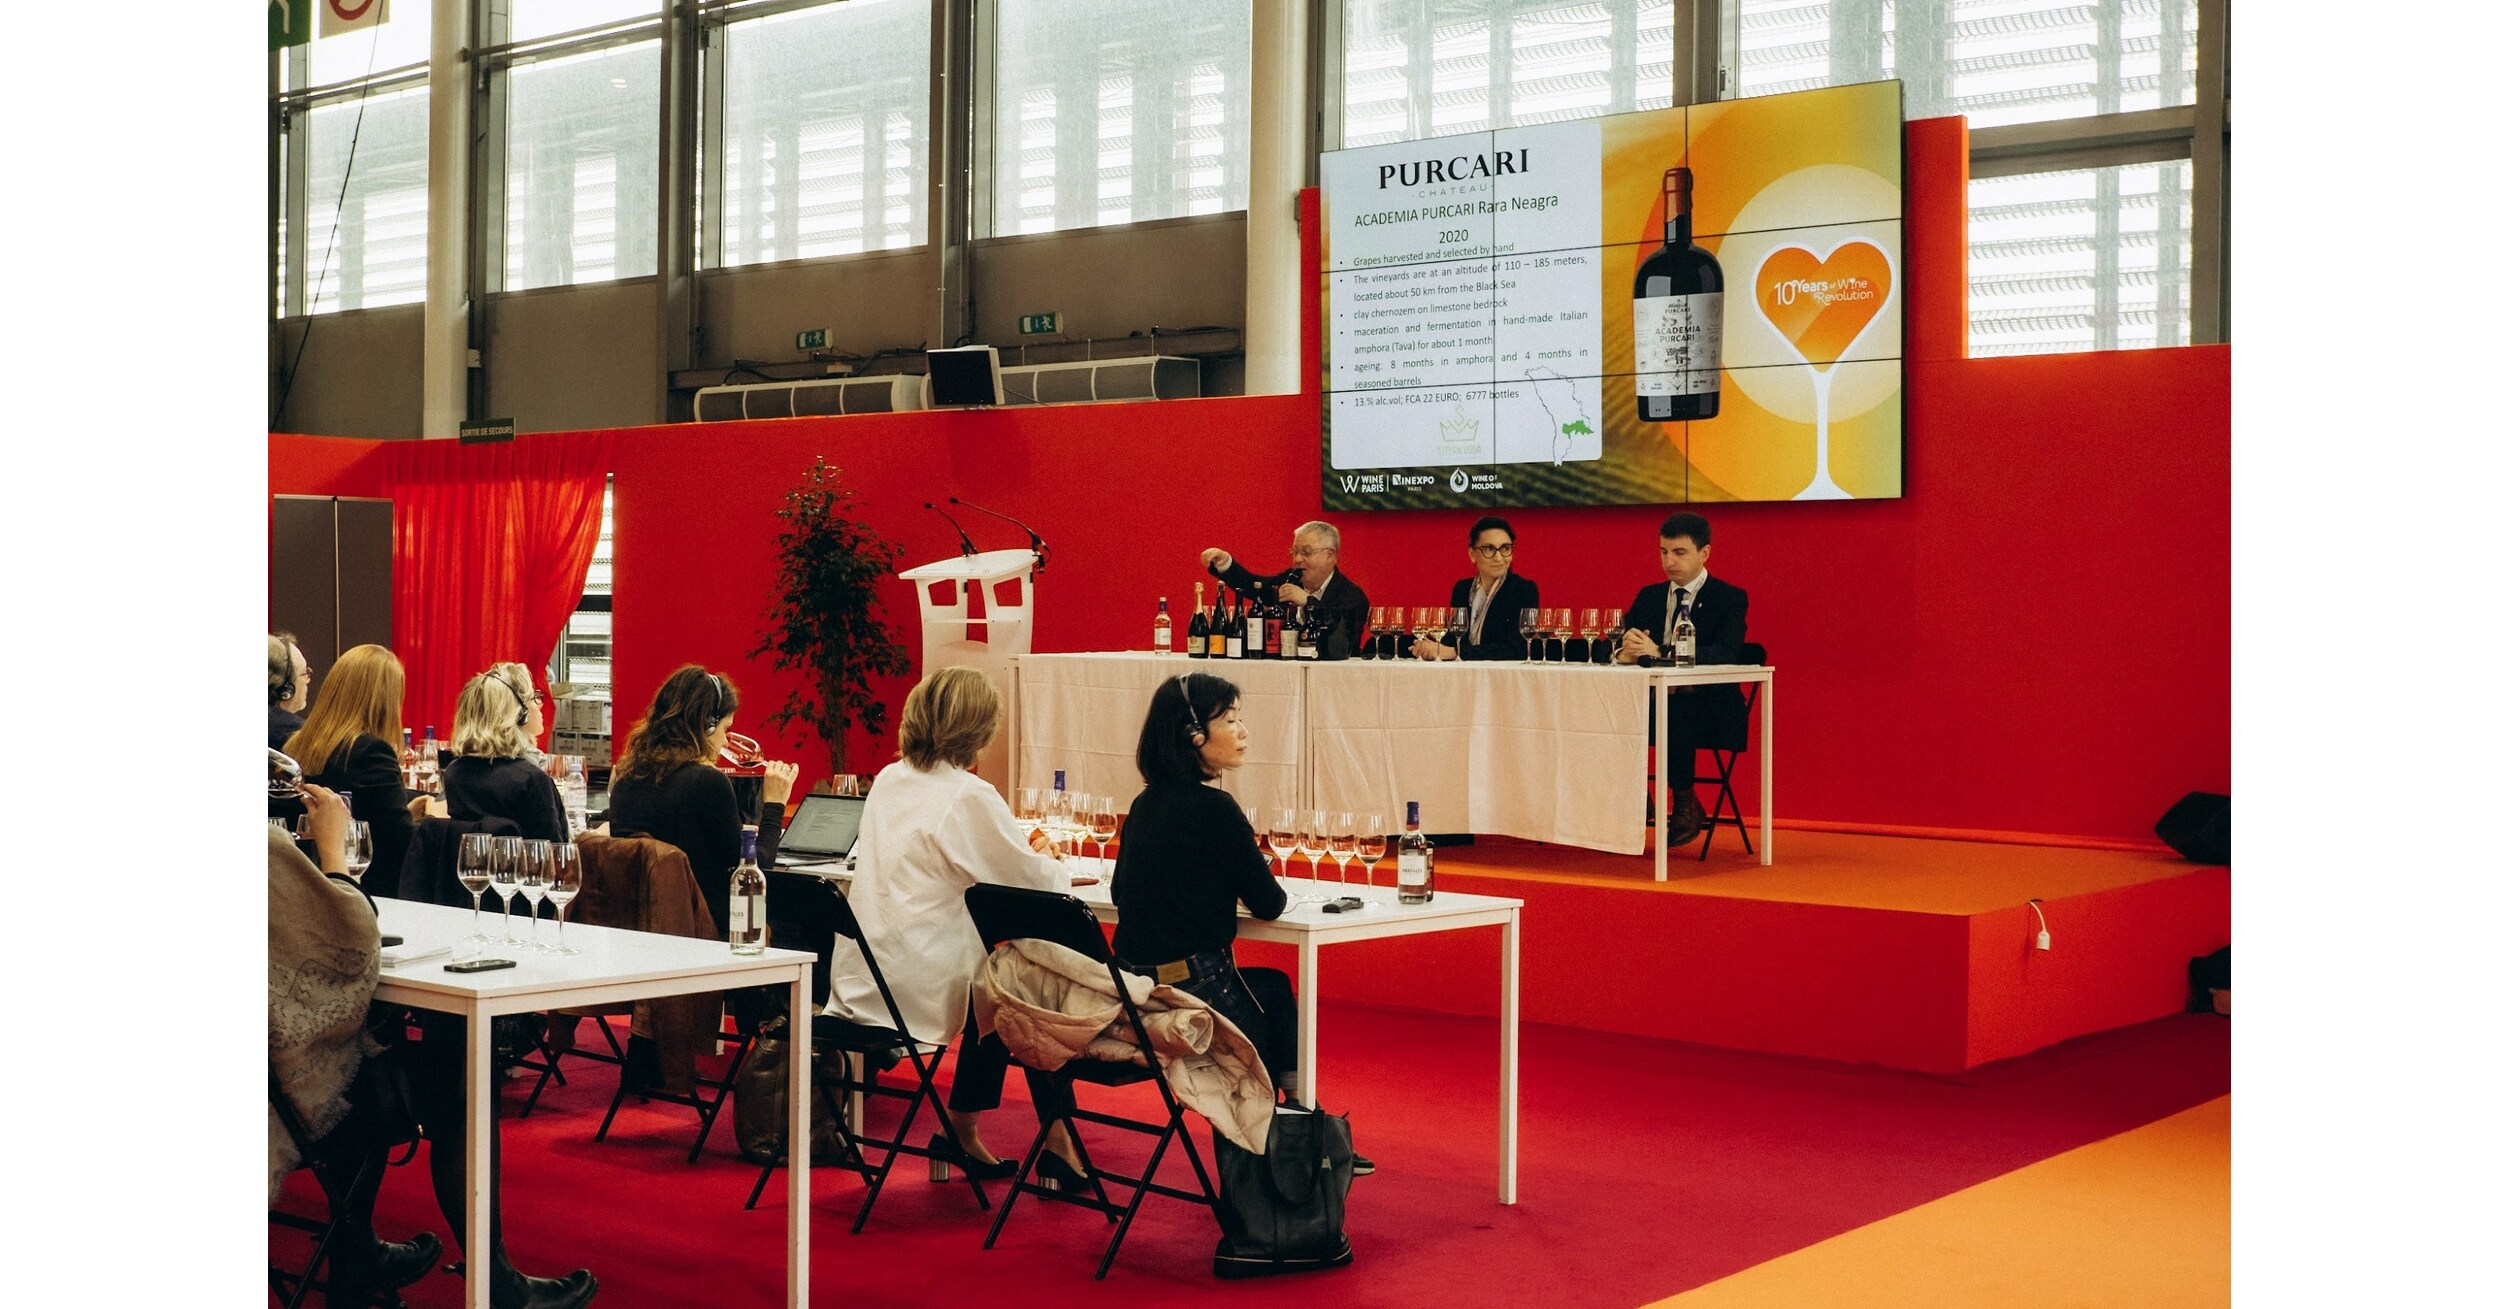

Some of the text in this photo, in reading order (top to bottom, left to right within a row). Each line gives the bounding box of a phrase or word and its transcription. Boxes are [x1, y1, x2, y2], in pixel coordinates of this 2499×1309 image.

[1378, 148, 1529, 190] PURCARI
[1418, 183, 1488, 199] CHATEAU
[1354, 195, 1559, 228] ACADEMIA PURCARI Rara Neagra
[1438, 229, 1469, 244] 2020
[1353, 242, 1514, 267] Grapes harvested and selected by hand
[1354, 275, 1368, 284] The
[1371, 271, 1410, 283] vineyards
[1413, 271, 1426, 279] are
[1429, 269, 1438, 277] at
[1441, 268, 1452, 276] an
[1455, 263, 1488, 275] altitude
[1492, 262, 1501, 271] of
[1505, 260, 1521, 271] 110
[1534, 258, 1550, 268] 185
[1554, 256, 1588, 266] meters,
[1354, 280, 1516, 302] located about 50 km from the Black Sea
[1775, 281, 1796, 305] 10
[1791, 279, 1828, 293] Years
[1814, 290, 1874, 306] Revolution
[1354, 298, 1508, 320] clay chernozem on limestone bedrock
[1354, 311, 1588, 337] maceration and fermentation in hand-made Italian
[1655, 325, 1701, 335] ACADEMIA
[1354, 336, 1493, 355] amphora (Tava) for about 1 month
[1660, 333, 1695, 343] PURCARI
[1354, 347, 1588, 373] ageing: 8 months in amphora and 4 months in
[1354, 376, 1421, 389] seasoned barrels
[1405, 394, 1421, 404] FCA
[1423, 393, 1433, 403] 22
[1465, 390, 1487, 401] 6777
[1489, 388, 1520, 399] bottles
[461, 426, 513, 437] SORTIE DE SECOURS
[1361, 475, 1384, 484] WINE
[1471, 474, 1488, 482] WINE
[1361, 483, 1384, 493] PARIS
[1471, 482, 1503, 491] MOLDOVA
